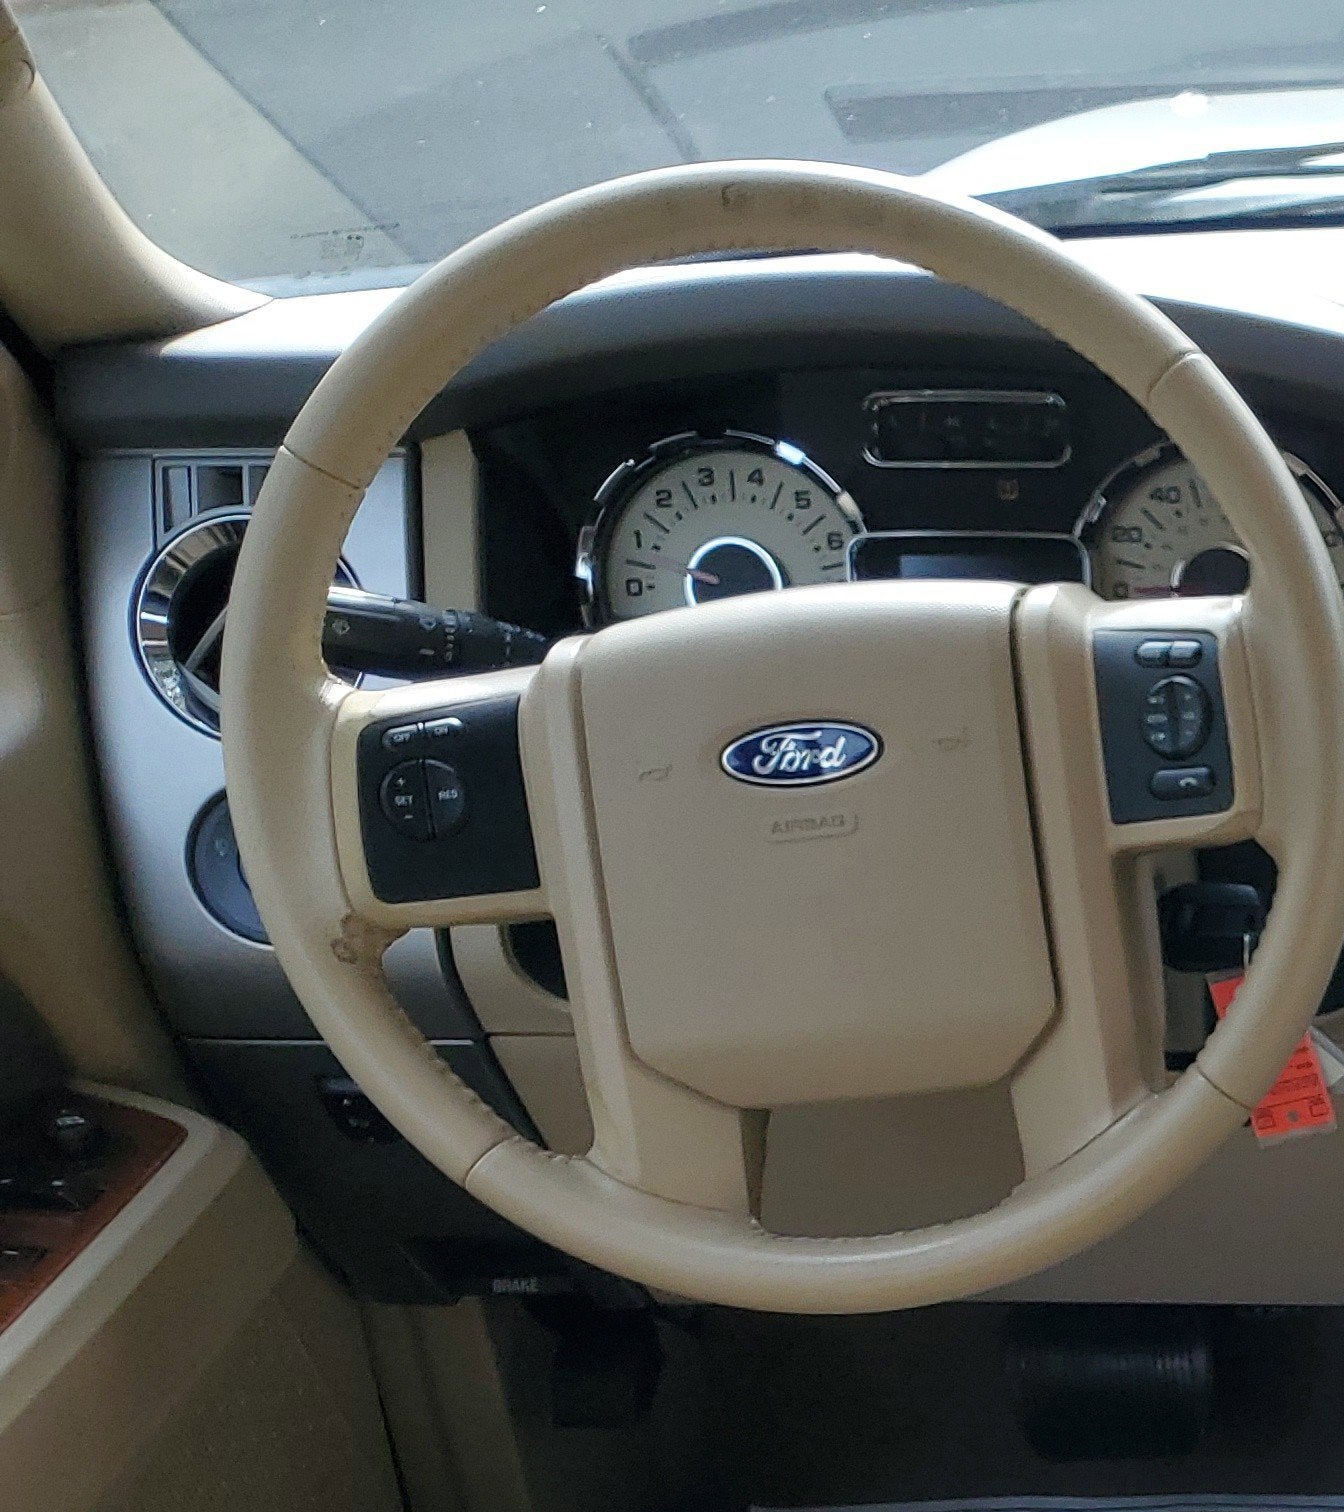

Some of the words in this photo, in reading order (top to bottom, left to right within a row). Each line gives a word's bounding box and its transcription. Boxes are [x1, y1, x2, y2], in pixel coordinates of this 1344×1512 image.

[698, 468, 715, 486] 3
[747, 468, 764, 486] 4
[656, 489, 672, 508] 2
[795, 490, 811, 509] 5
[633, 529, 643, 549] 1
[827, 532, 844, 550] 6
[626, 578, 643, 597] 0
[752, 730, 848, 775] Ford
